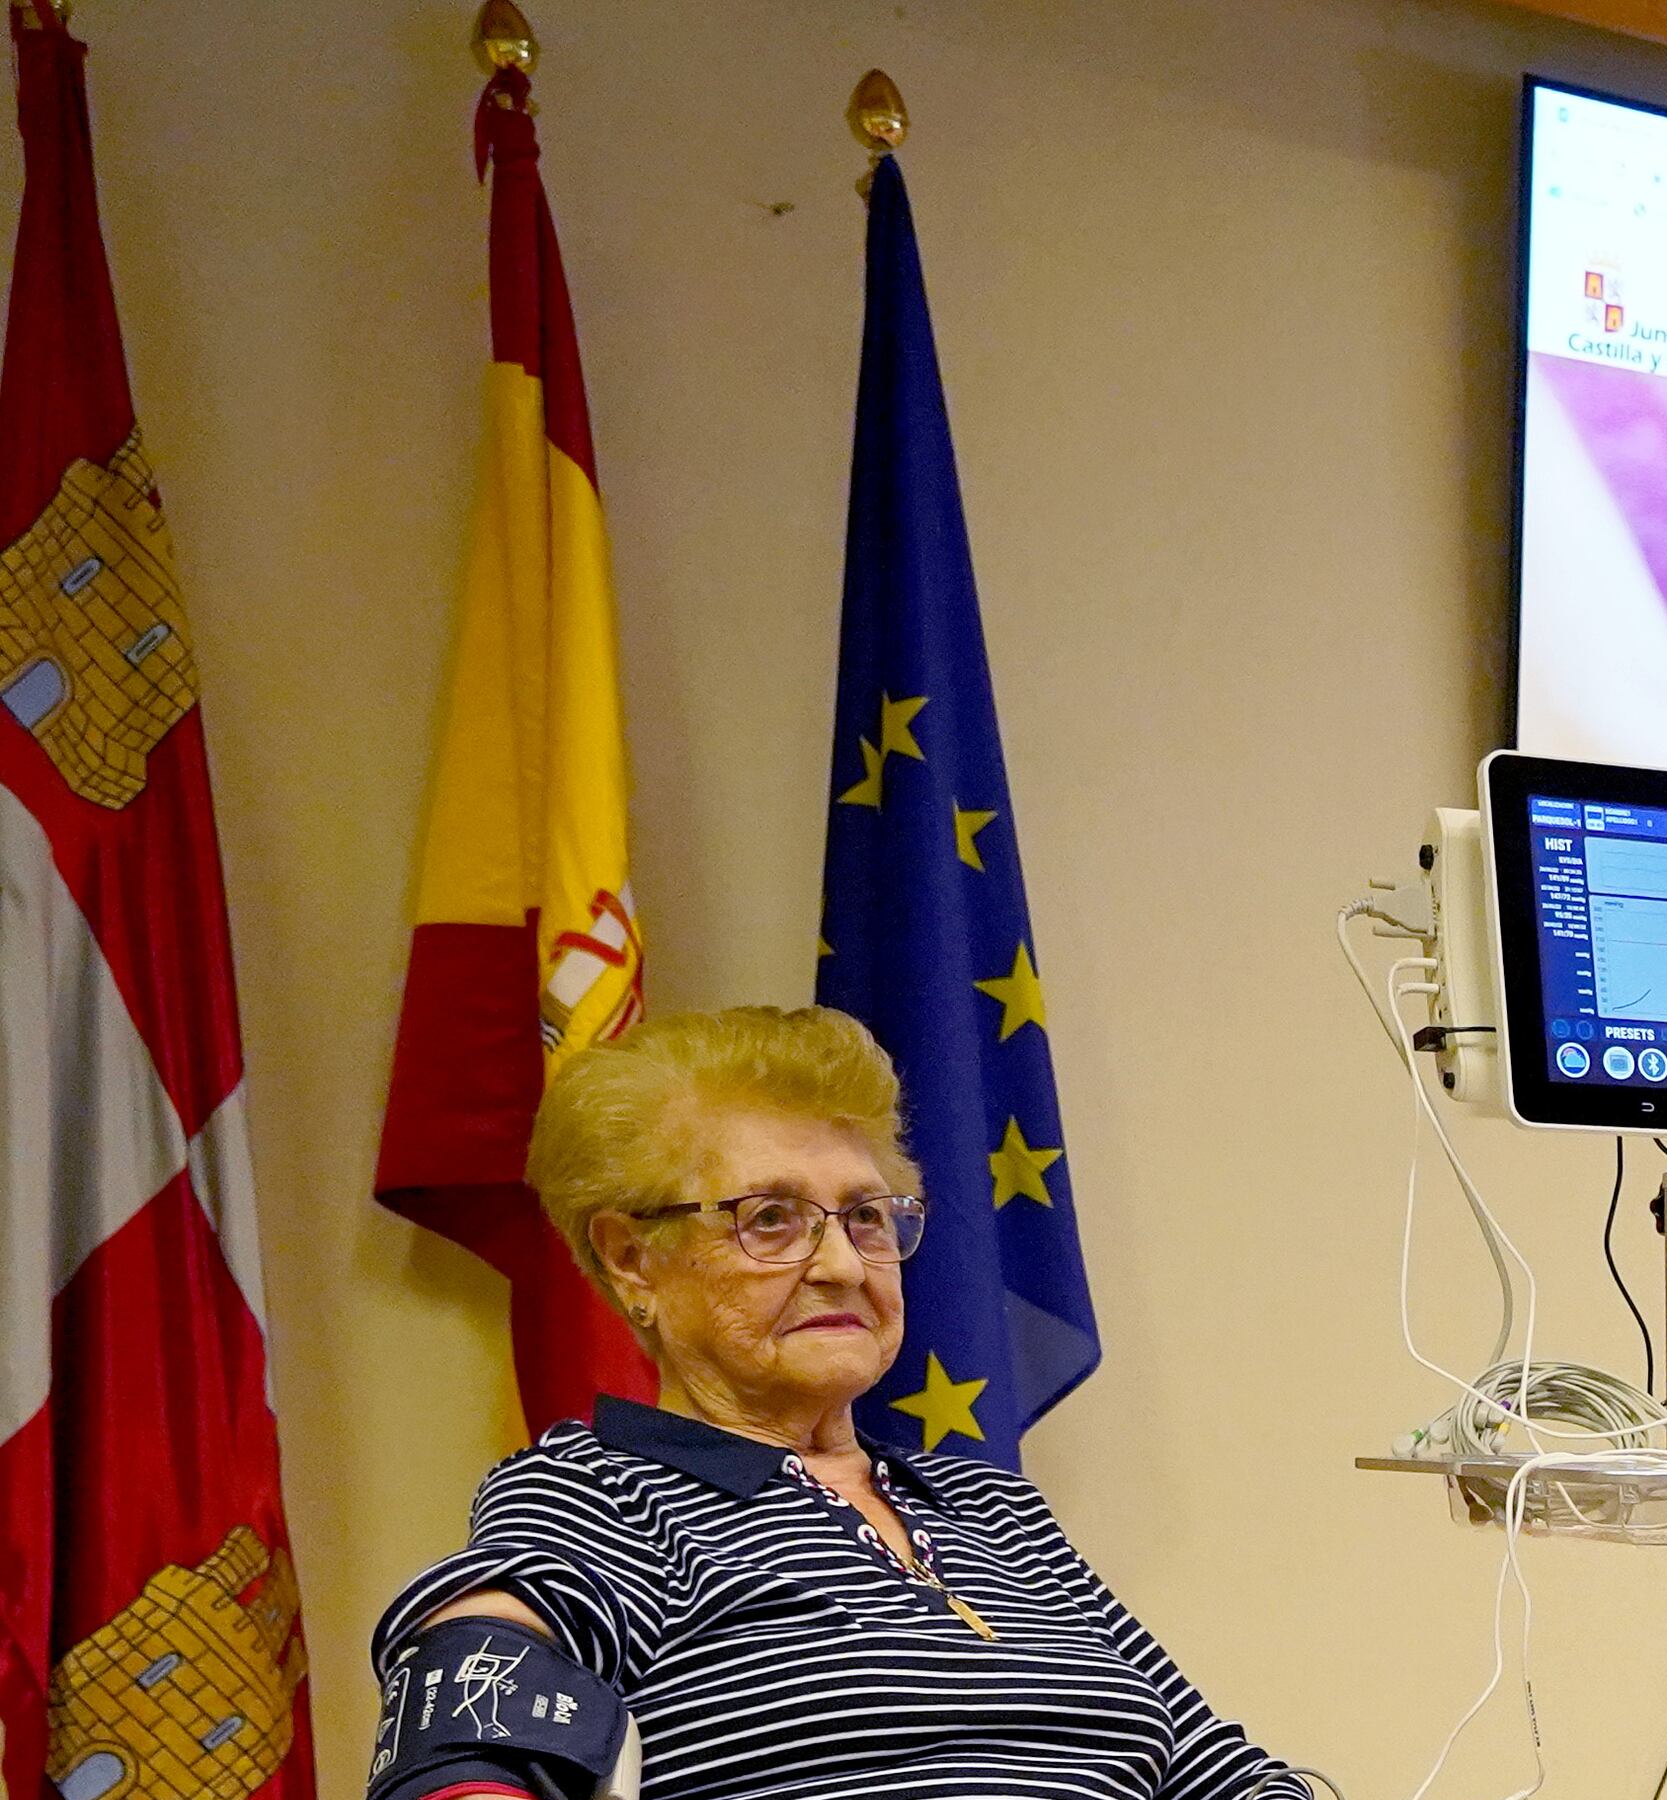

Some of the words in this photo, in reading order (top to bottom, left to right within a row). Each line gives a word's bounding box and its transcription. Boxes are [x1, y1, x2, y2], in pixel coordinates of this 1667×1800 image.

[1567, 333, 1643, 364] Castilla
[1651, 353, 1663, 373] y
[1544, 837, 1573, 852] HIST
[1605, 1026, 1655, 1041] PRESETS
